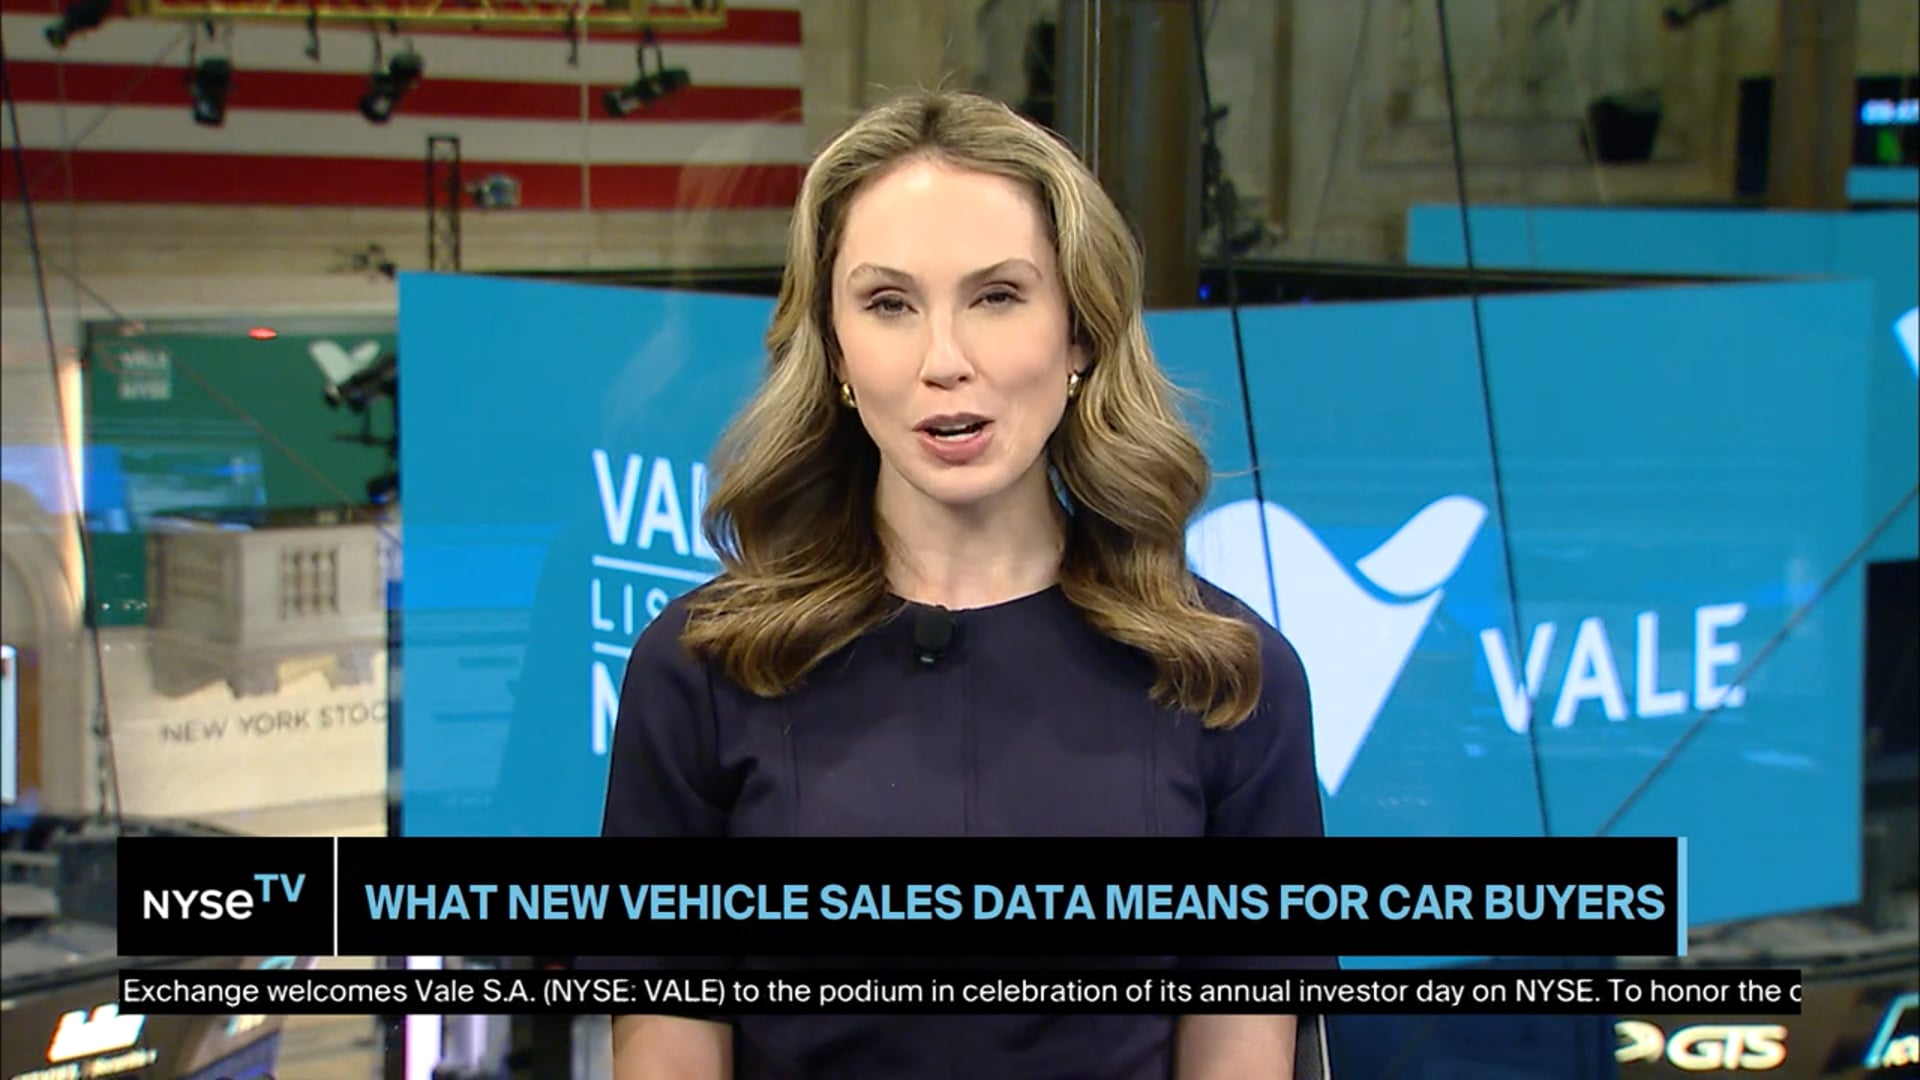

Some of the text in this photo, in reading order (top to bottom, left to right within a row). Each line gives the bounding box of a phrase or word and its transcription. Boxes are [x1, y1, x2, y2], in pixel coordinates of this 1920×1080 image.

[592, 449, 742, 562] VAL
[1479, 602, 1747, 733] VALE
[161, 718, 228, 742] NEW
[240, 709, 310, 736] YORK
[1667, 1024, 1788, 1070] GTS
